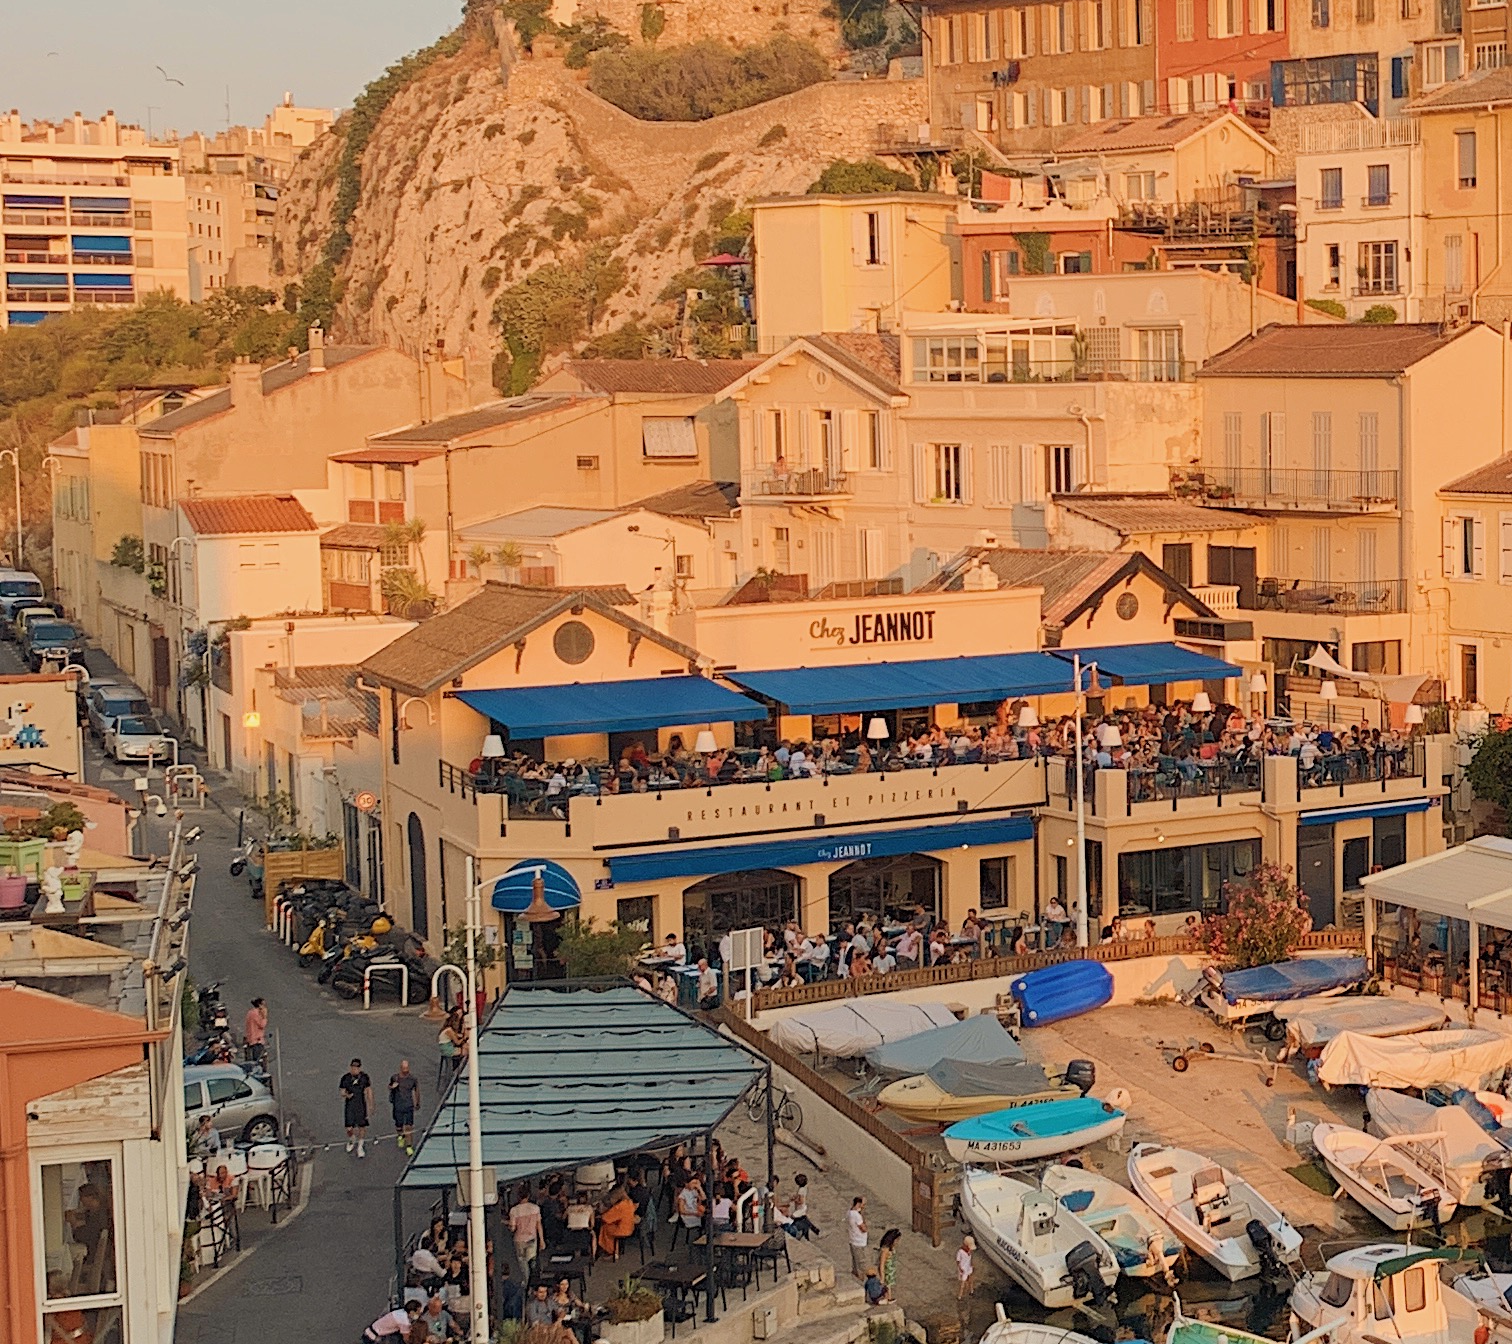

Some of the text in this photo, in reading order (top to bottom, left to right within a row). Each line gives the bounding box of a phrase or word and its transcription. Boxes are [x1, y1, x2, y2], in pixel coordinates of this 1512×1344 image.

[809, 610, 936, 645] Chez JEANNOT
[686, 786, 957, 822] RESTAURANT ET PIZZERIA
[832, 842, 872, 859] JEANNOT
[967, 1141, 1022, 1151] MA 431653
